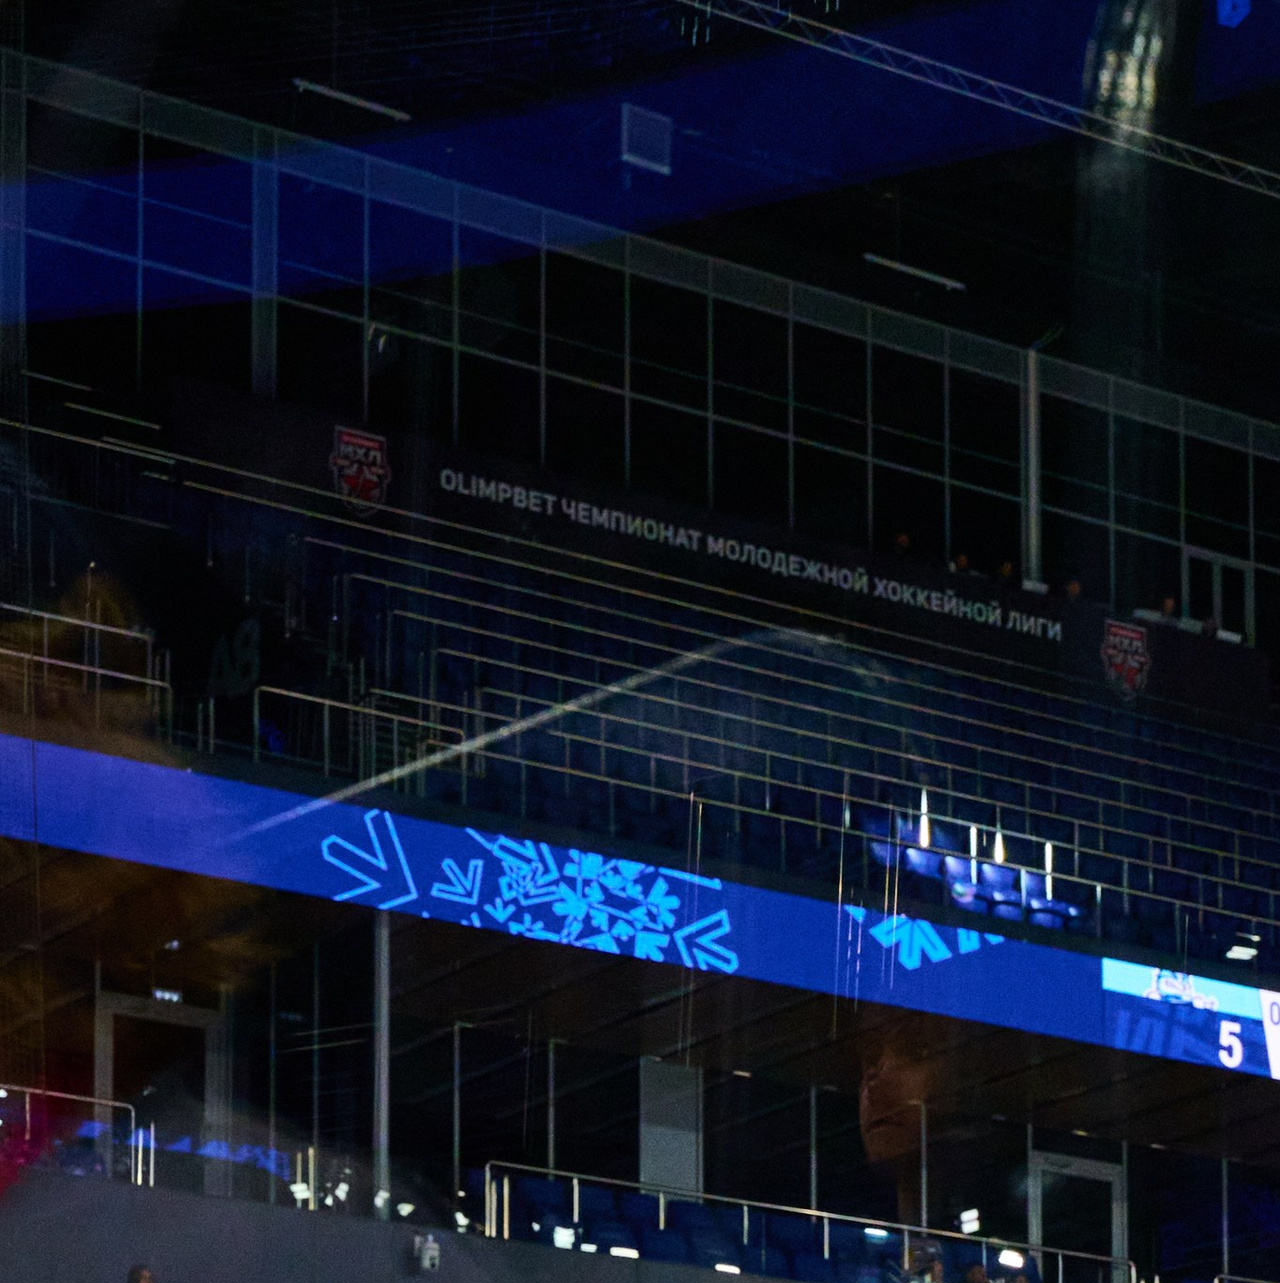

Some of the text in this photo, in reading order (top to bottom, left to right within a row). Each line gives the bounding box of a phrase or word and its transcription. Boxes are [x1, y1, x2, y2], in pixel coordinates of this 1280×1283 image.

[559, 499, 702, 553] ЧЕМПИОНАТ
[706, 534, 869, 595] МОЛОДЕЖНОЙ
[872, 576, 1003, 628] ХОККЕЙНОЙ
[1007, 610, 1063, 644] ЛИГИ
[1219, 1021, 1244, 1069] 5
